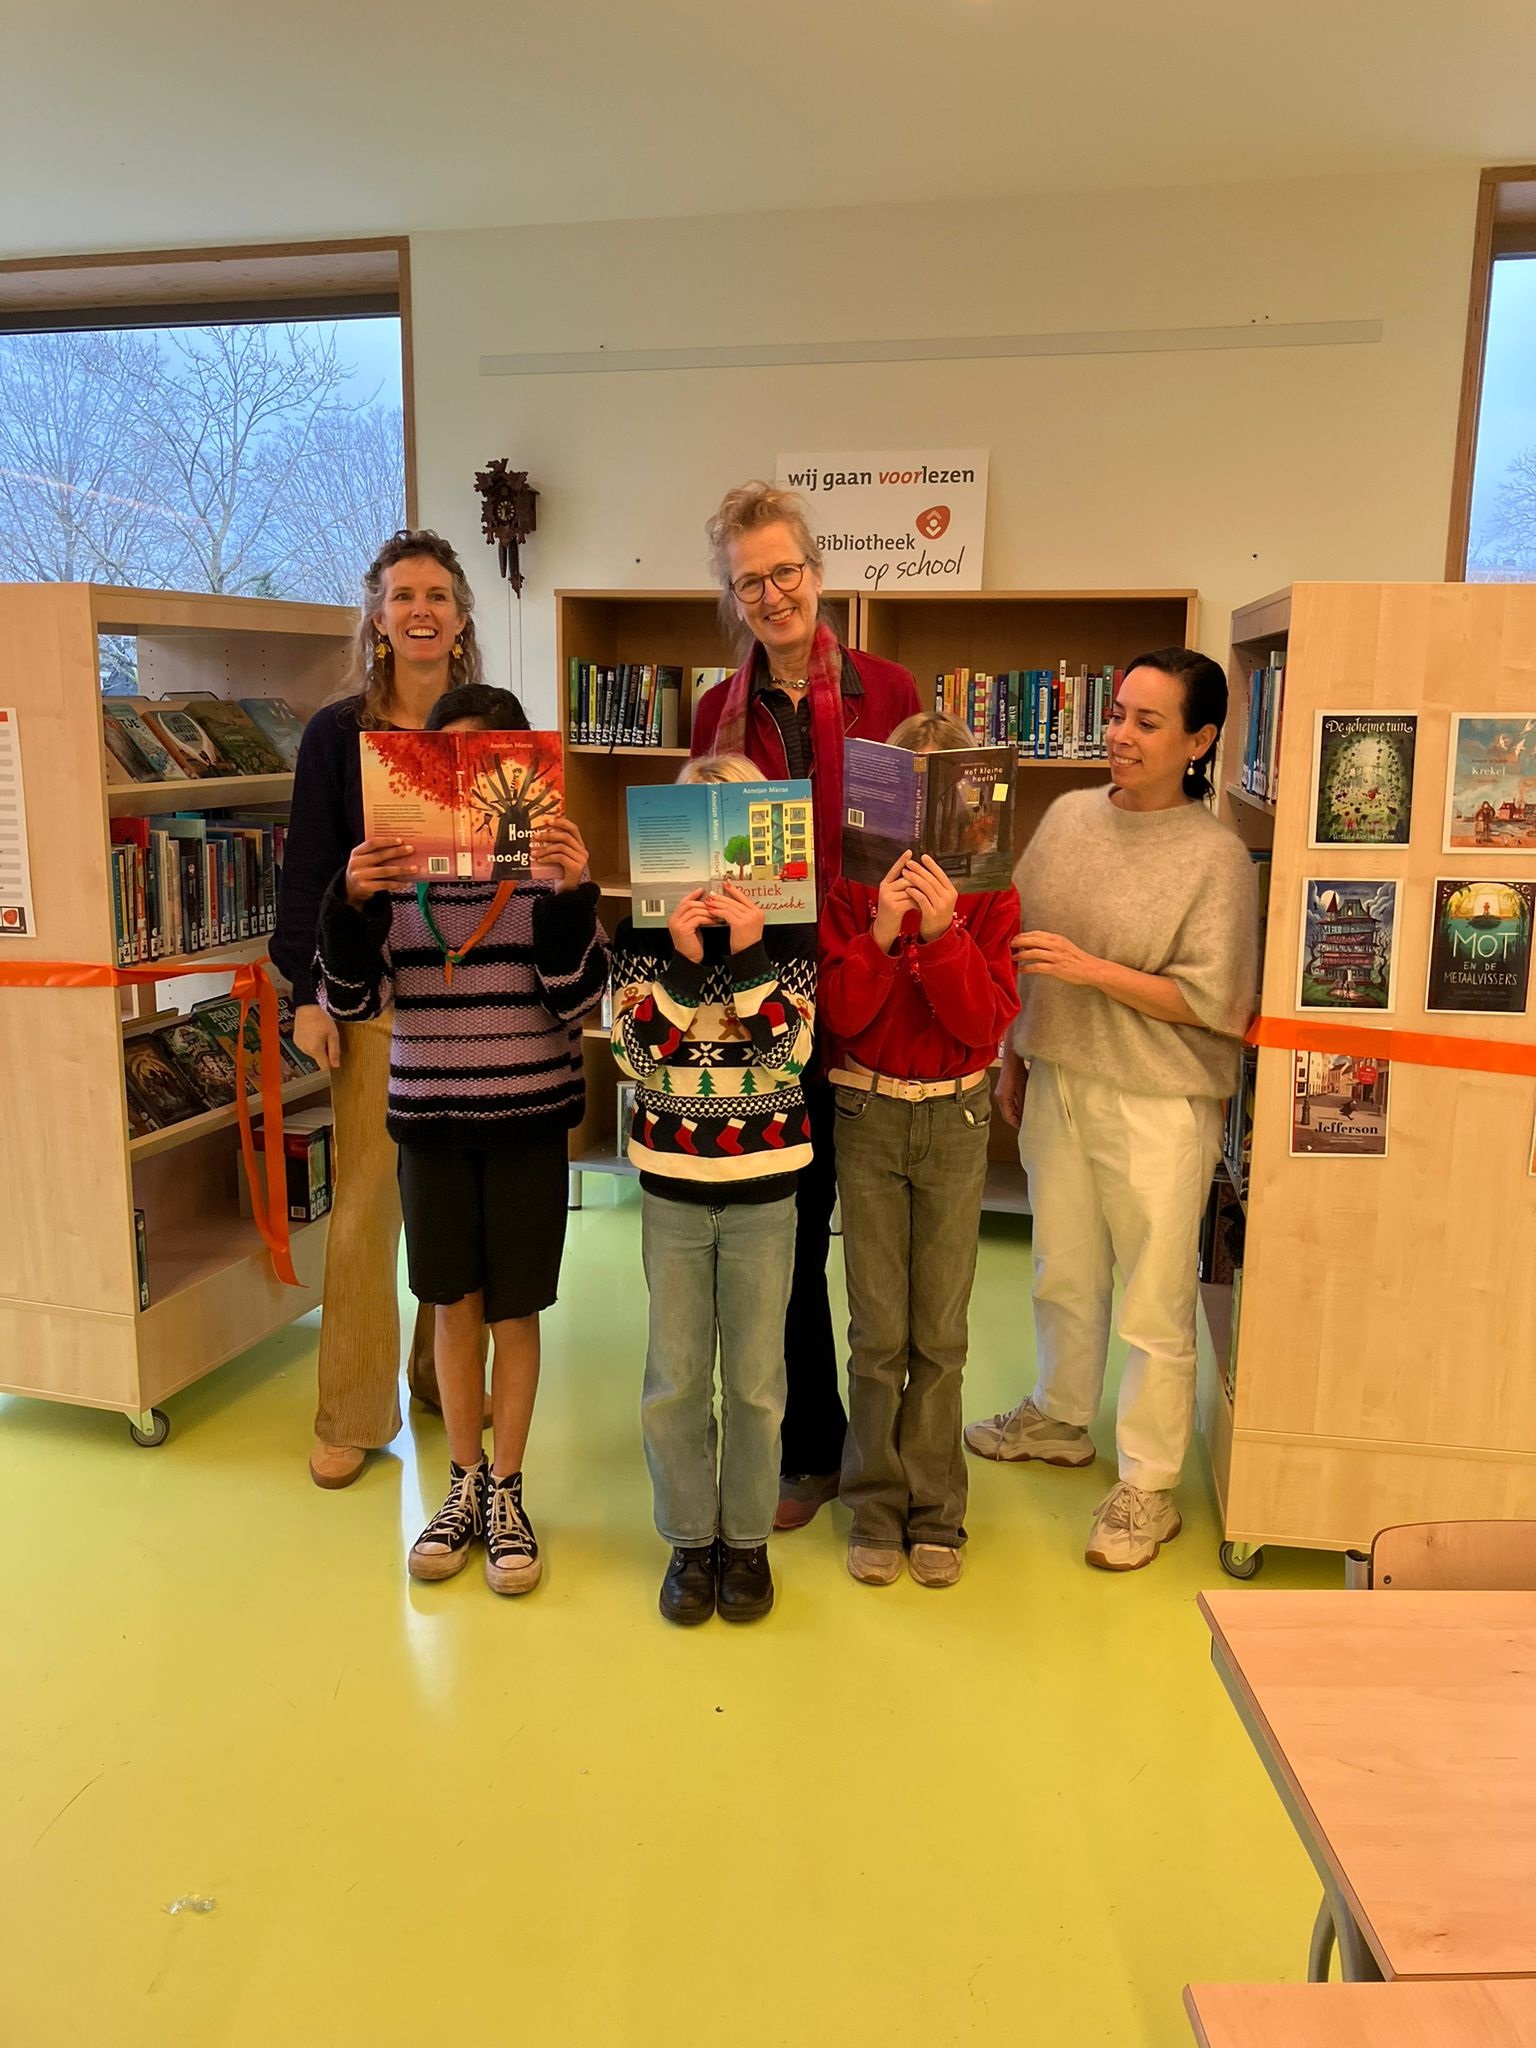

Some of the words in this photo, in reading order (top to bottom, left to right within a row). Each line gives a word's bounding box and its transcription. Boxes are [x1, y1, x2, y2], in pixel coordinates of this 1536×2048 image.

[788, 469, 818, 491] wij
[823, 471, 872, 491] gaan
[879, 466, 975, 485] voorlezen
[816, 533, 915, 551] Bibliotheek
[864, 563, 889, 591] op
[897, 546, 965, 580] school
[1325, 719, 1345, 733] De
[1341, 717, 1386, 737] geheime
[1386, 721, 1413, 733] tuin
[1472, 766, 1506, 775] Krekel
[1452, 930, 1519, 962] MOT
[1463, 962, 1477, 971] EN
[1485, 962, 1497, 971] DE
[1443, 972, 1518, 986] METAALVISSERS
[208, 1005, 240, 1024] ROALD
[1315, 1121, 1378, 1135] Jefferson
